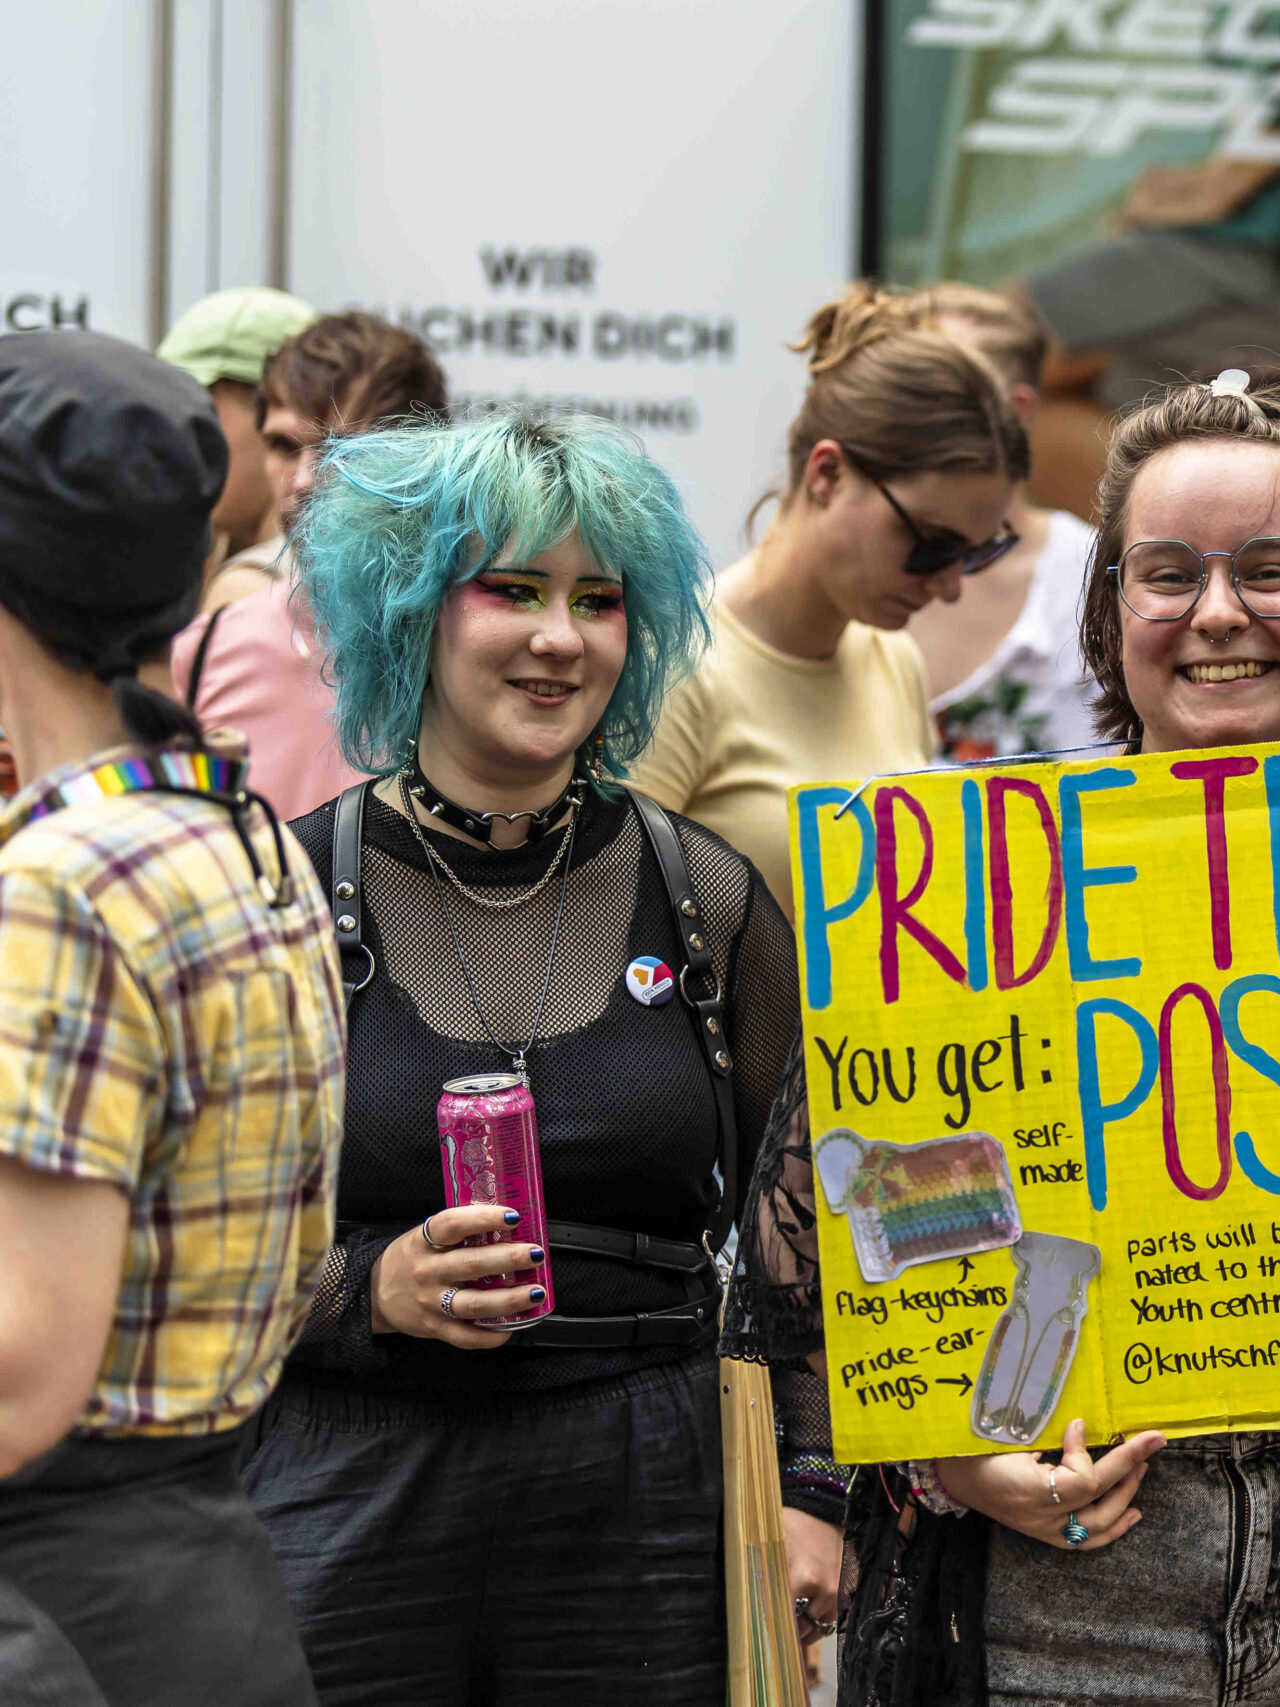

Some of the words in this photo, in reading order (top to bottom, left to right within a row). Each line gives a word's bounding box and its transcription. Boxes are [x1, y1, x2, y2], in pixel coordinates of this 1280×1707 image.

[478, 246, 598, 292] WIR
[593, 310, 738, 362] DICH
[797, 768, 1142, 1010] PRIDE
[936, 1014, 1053, 1130] get:
[1013, 1122, 1074, 1149] self-
[1018, 1159, 1084, 1186] made
[1127, 1231, 1196, 1263] parts
[1206, 1222, 1256, 1249] will
[1135, 1261, 1210, 1289] nated
[1215, 1259, 1248, 1281] to
[856, 1373, 929, 1410] rings
